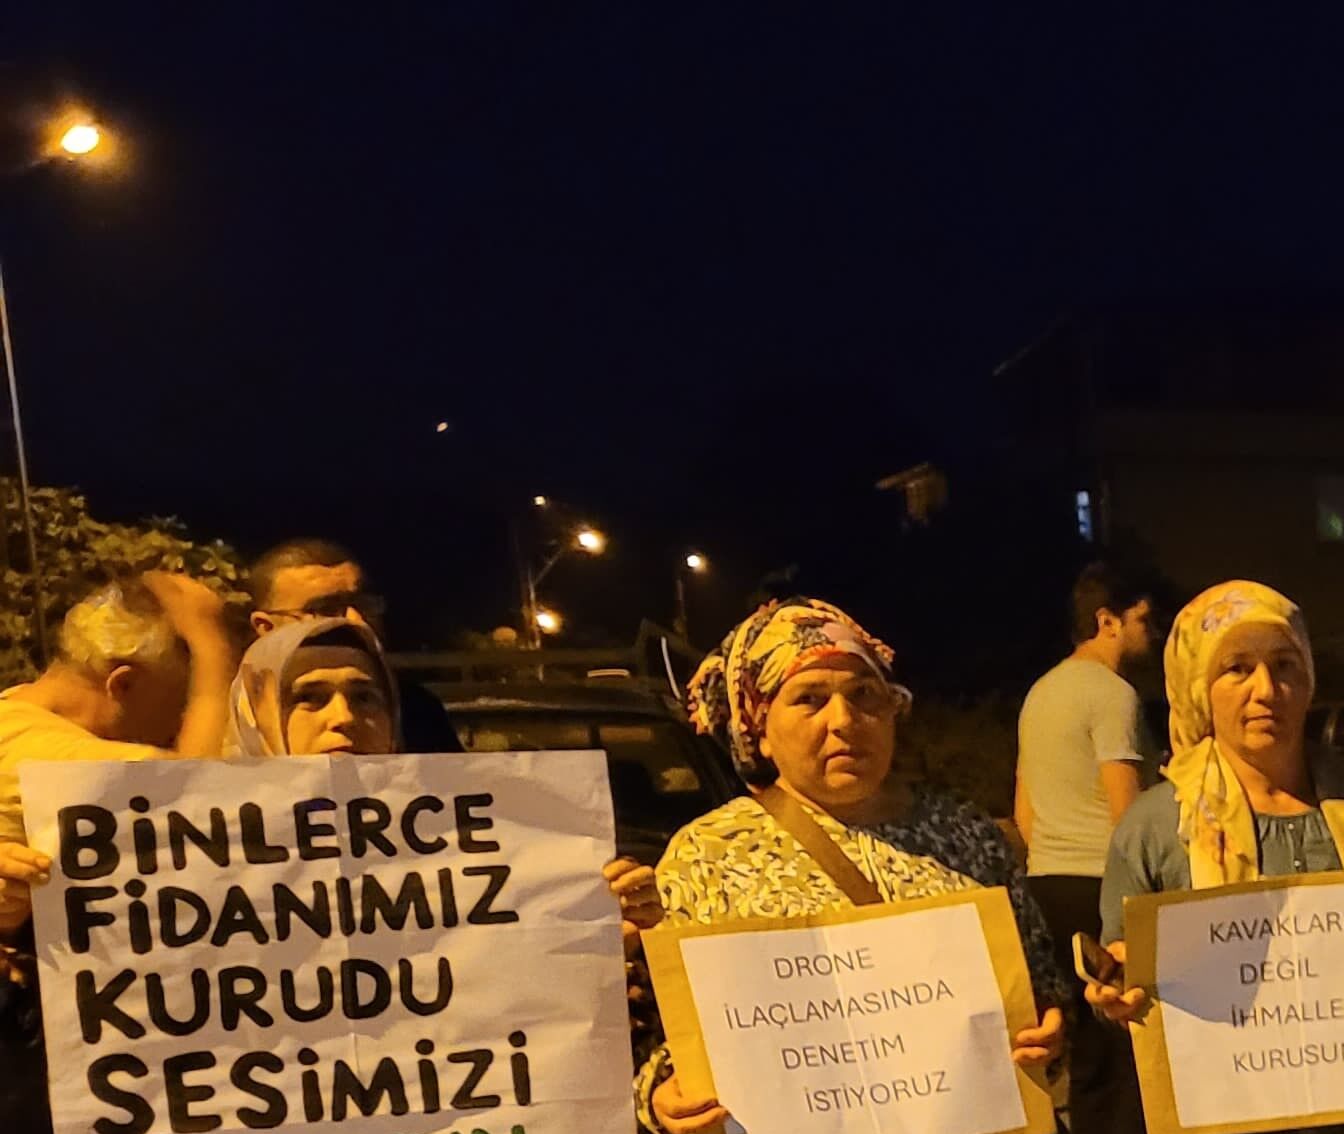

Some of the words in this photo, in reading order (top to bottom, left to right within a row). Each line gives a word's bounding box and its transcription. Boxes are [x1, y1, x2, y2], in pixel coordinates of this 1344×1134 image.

[773, 947, 875, 980] DRONE
[1239, 954, 1319, 985] DEĞİL
[75, 957, 454, 1044] KURUDU
[723, 978, 955, 1031] İLAÇLAMASINDA
[781, 1034, 905, 1071] DENETİM
[804, 1071, 951, 1114] İSTİYORUZ
